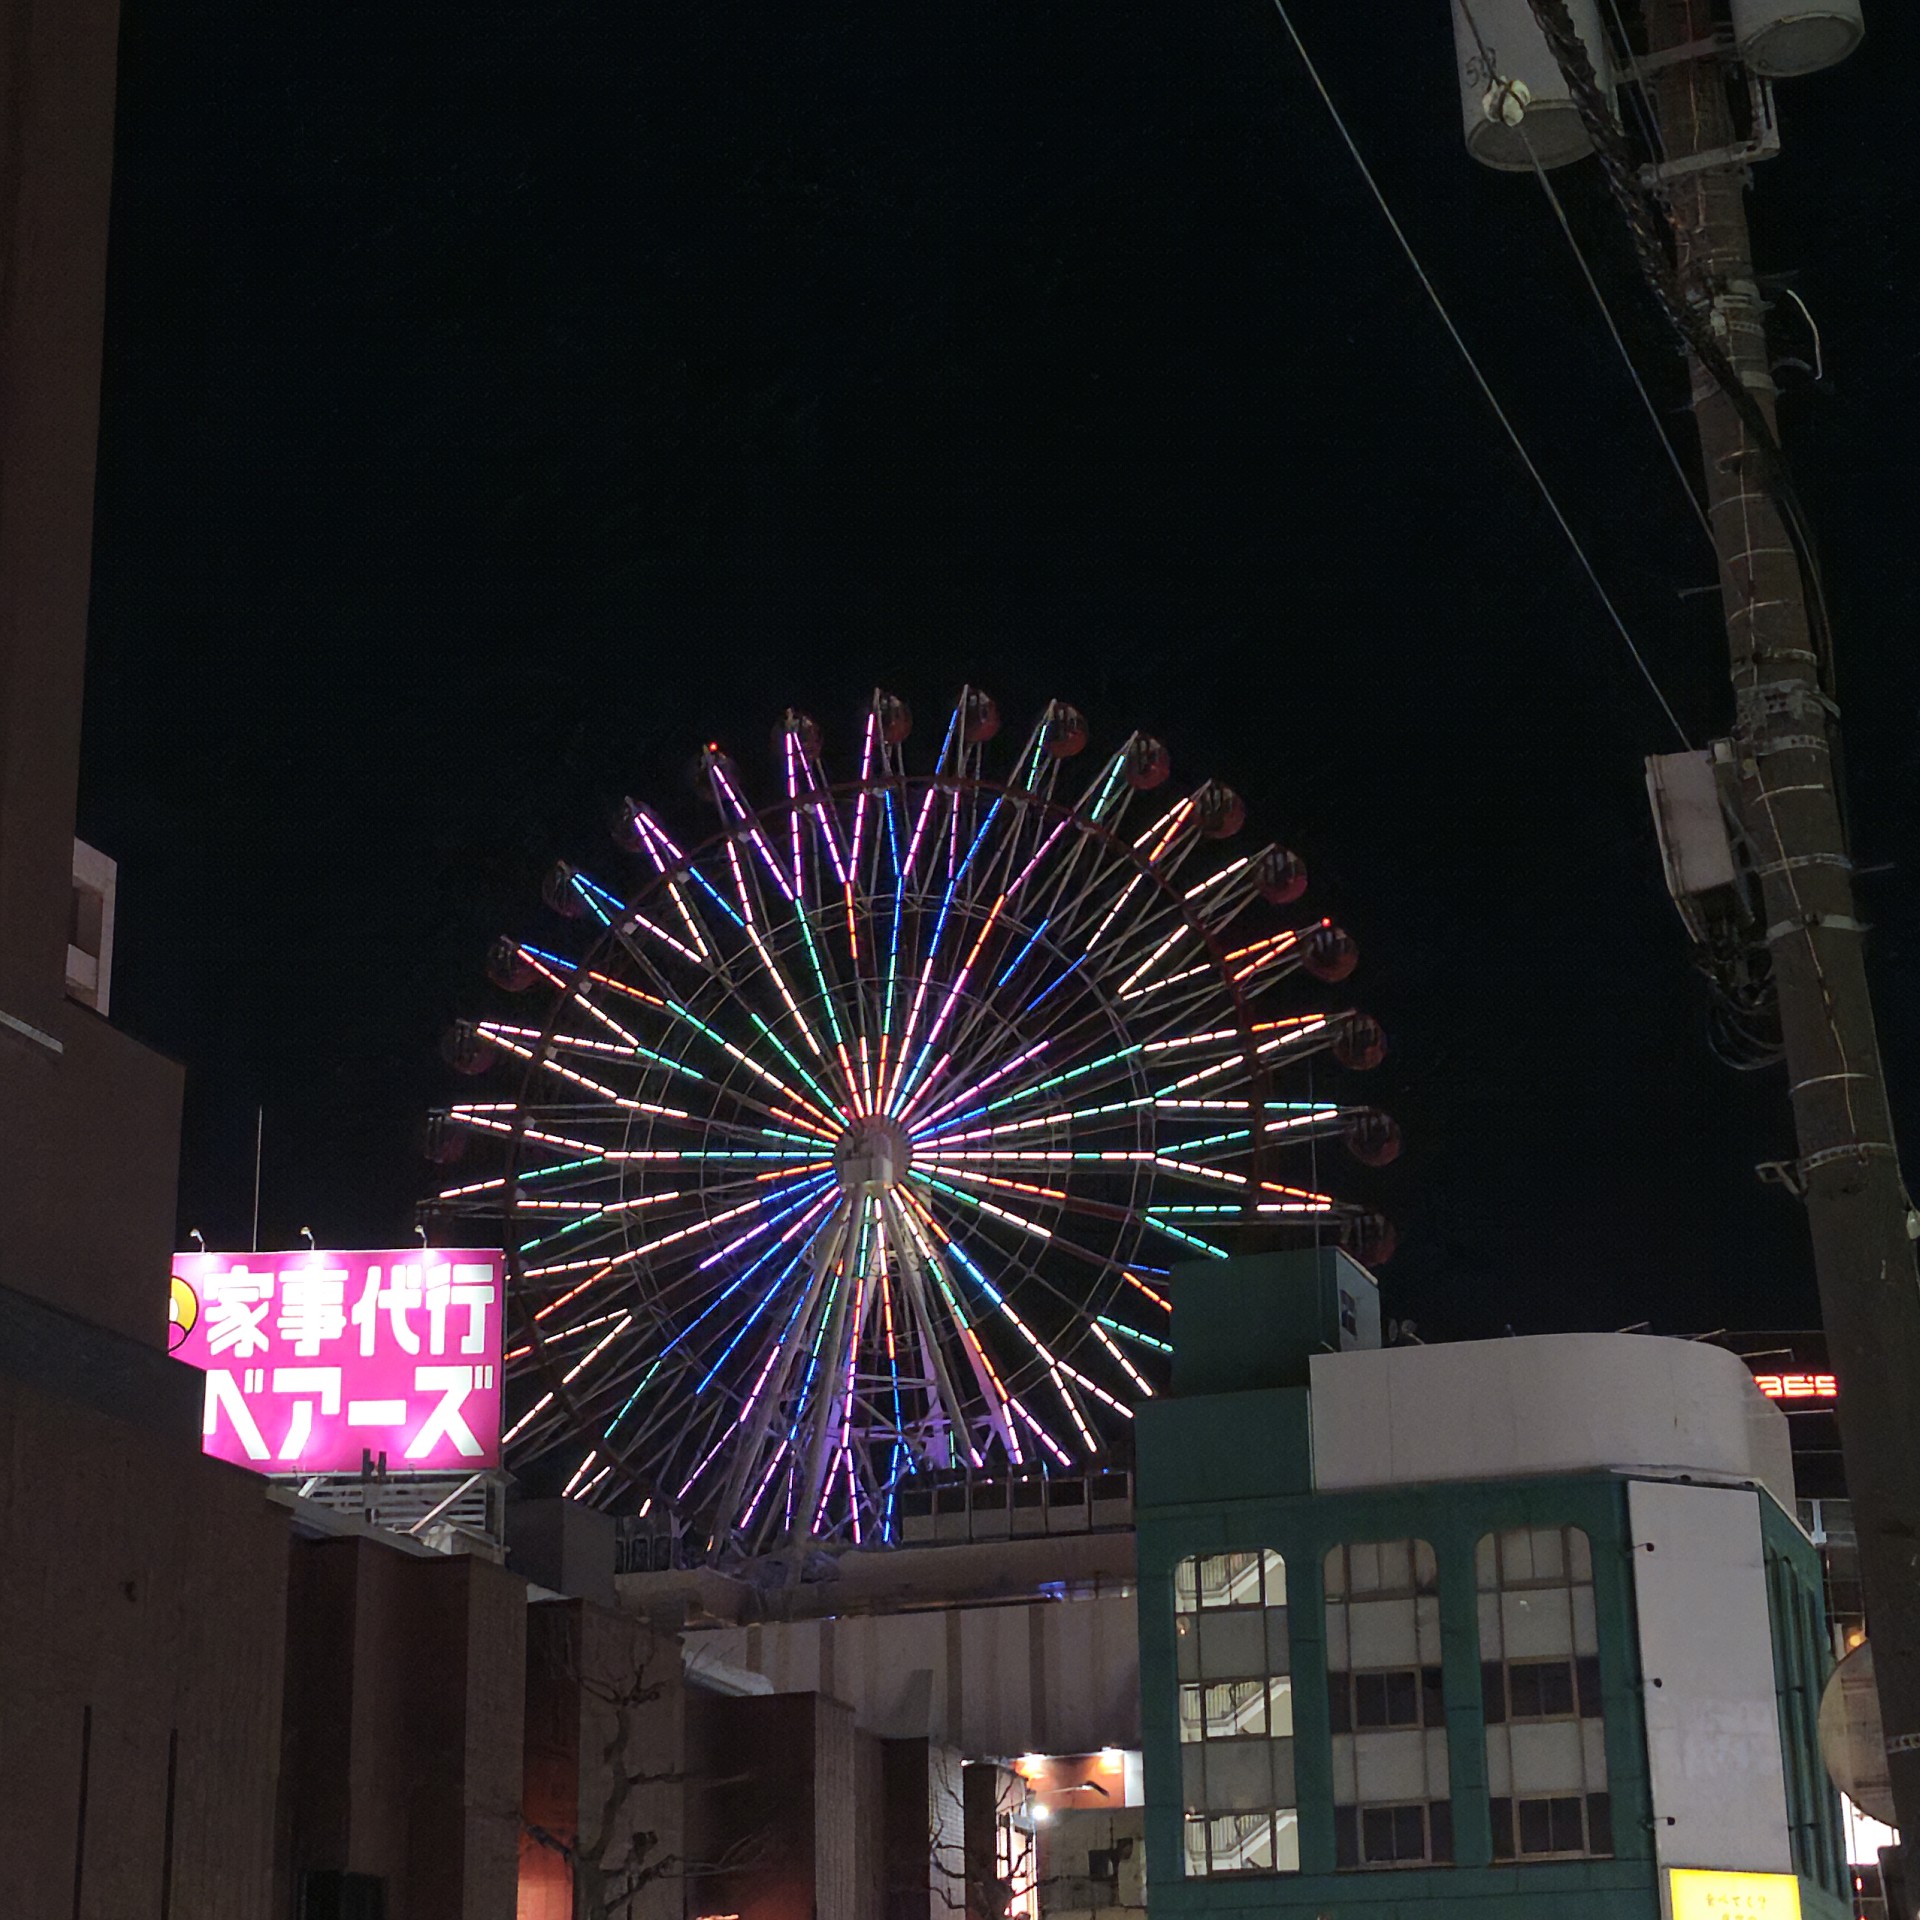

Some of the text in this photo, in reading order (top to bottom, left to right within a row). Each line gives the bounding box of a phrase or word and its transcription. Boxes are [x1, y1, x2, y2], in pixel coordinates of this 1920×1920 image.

[203, 1264, 494, 1357] 家事代行
[203, 1366, 493, 1460] ベアーズ
